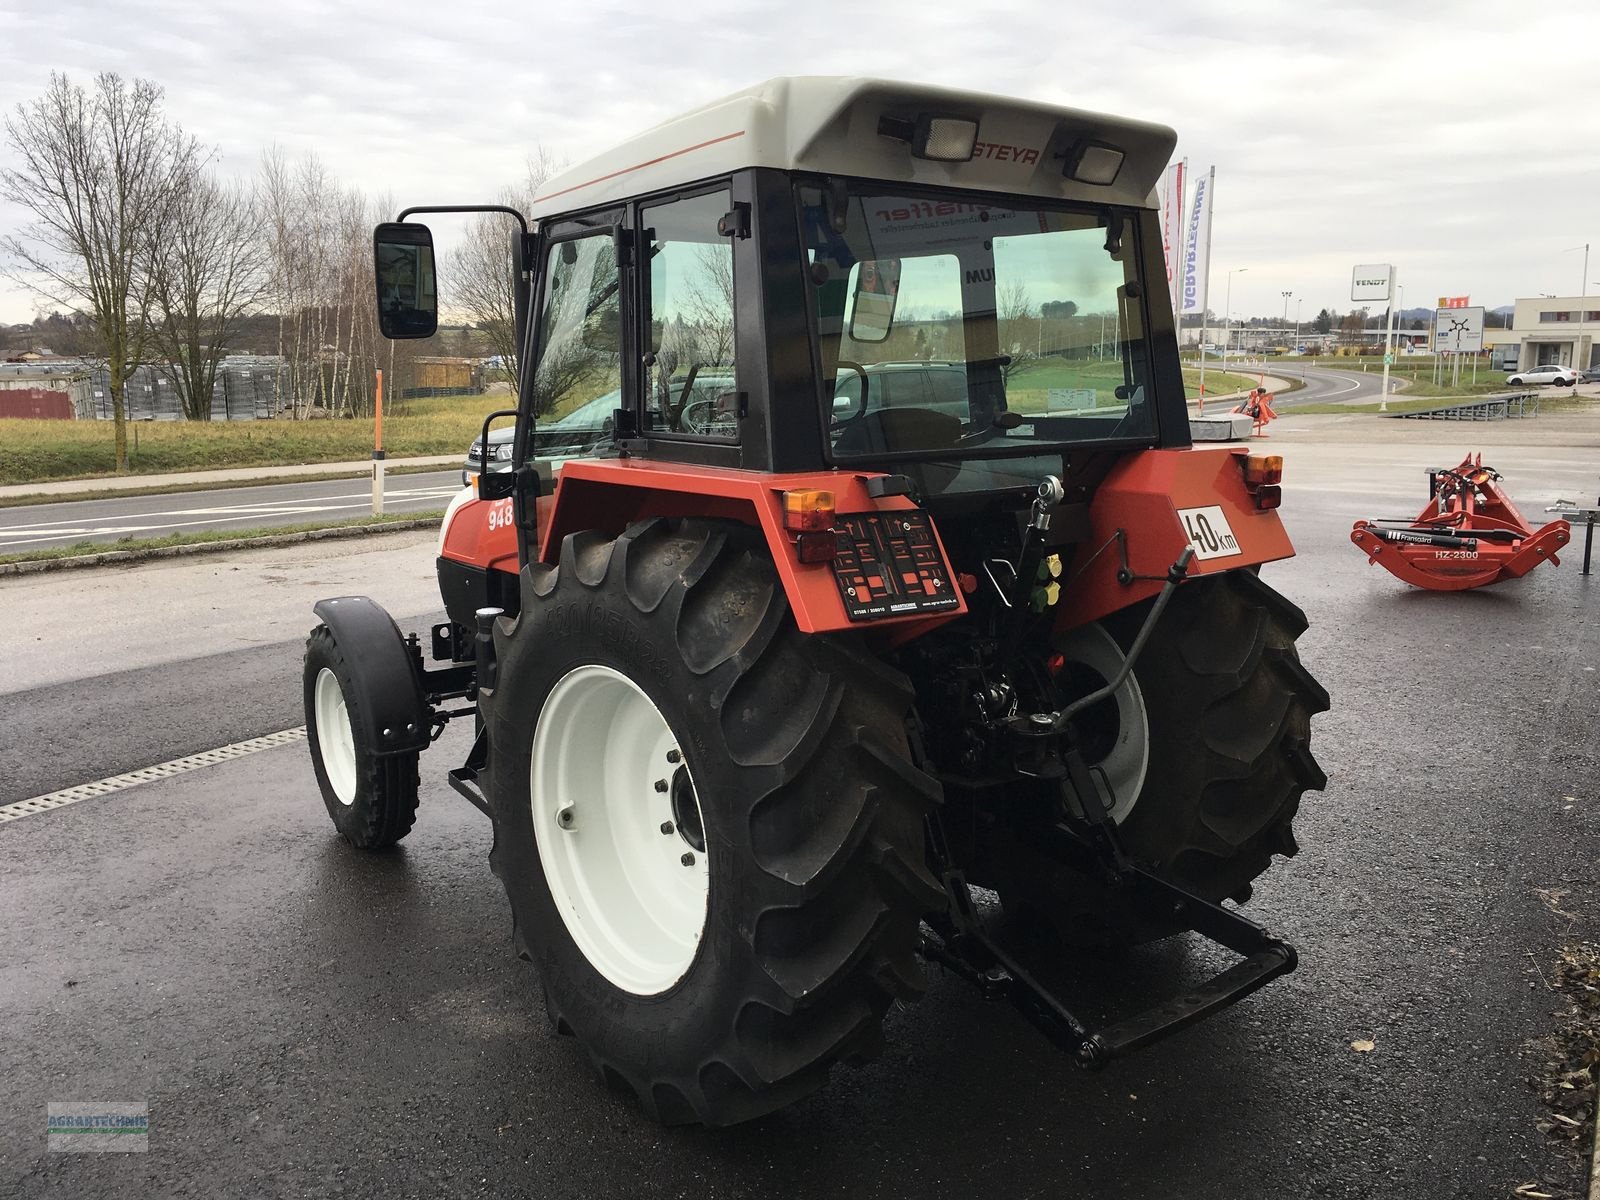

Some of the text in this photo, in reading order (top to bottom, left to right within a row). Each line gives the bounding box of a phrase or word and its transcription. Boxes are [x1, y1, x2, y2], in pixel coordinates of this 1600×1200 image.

[973, 142, 1040, 165] STEYR
[1356, 279, 1387, 287] FENDT
[488, 505, 513, 531] 948
[1185, 513, 1219, 553] 40
[1435, 551, 1478, 560] HZ-2300
